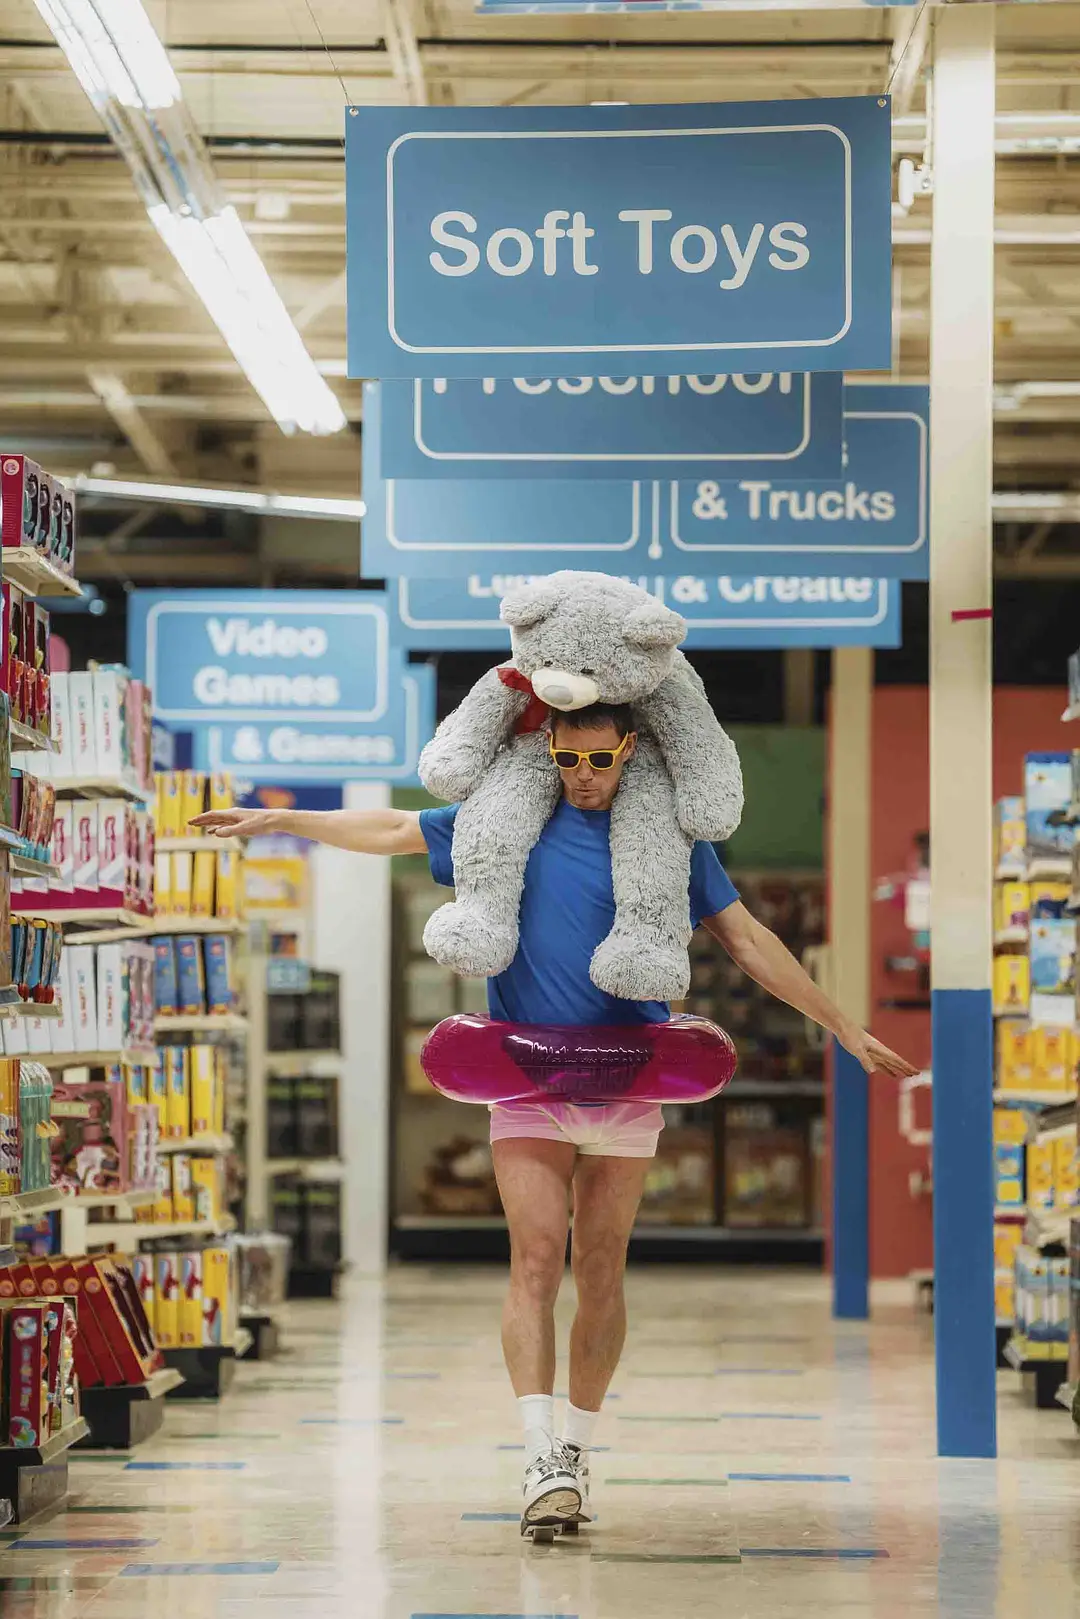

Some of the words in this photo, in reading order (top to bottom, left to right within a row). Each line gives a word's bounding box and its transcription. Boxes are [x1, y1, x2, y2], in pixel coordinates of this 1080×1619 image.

[429, 210, 599, 277] Soft
[618, 208, 811, 290] Toys
[692, 480, 728, 520] &
[738, 481, 896, 521] Trucks
[671, 576, 709, 604] &
[206, 617, 328, 658] Video
[193, 665, 340, 706] Games
[231, 726, 263, 762] &
[268, 726, 395, 763] Games
